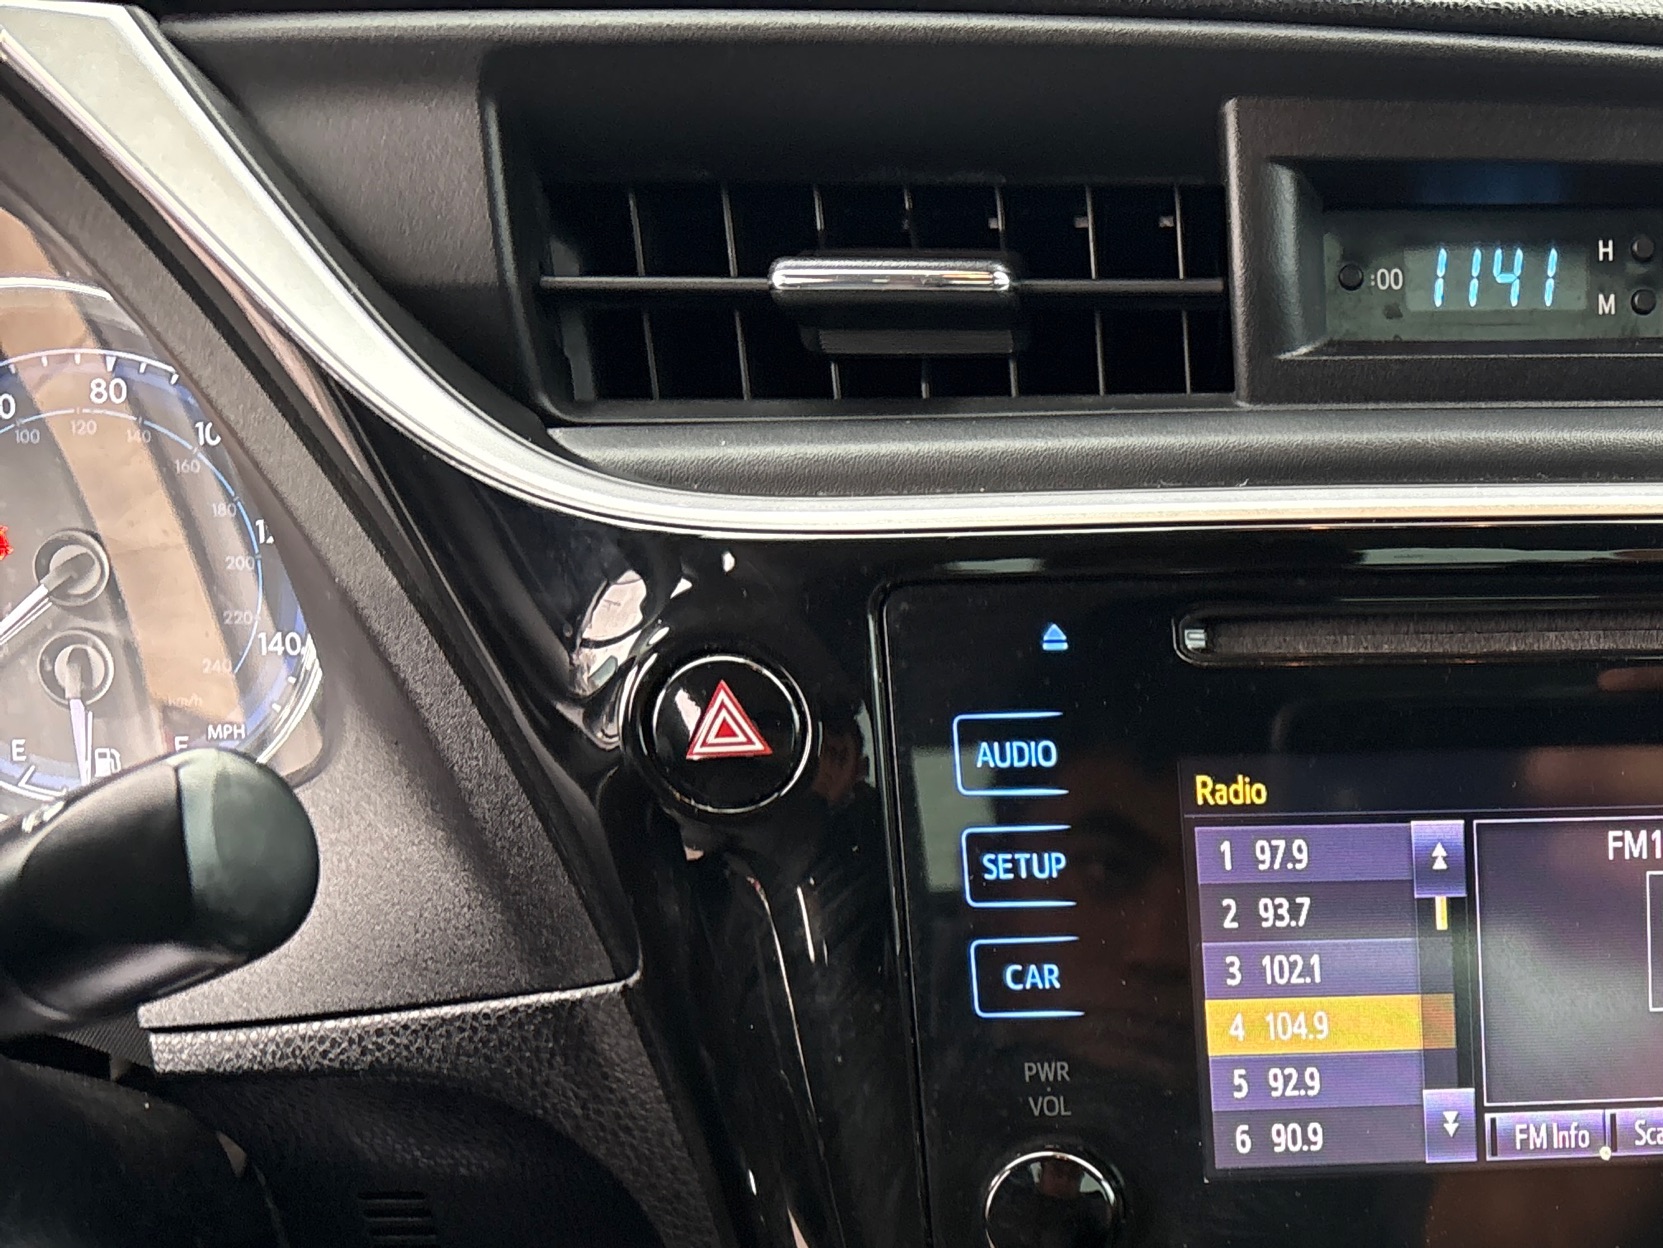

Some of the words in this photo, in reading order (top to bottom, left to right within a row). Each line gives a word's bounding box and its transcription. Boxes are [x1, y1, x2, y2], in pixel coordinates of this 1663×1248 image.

[1597, 239, 1614, 262] H
[1433, 247, 1558, 308] 1141
[1597, 293, 1616, 315] M
[89, 376, 128, 404] 80
[14, 429, 41, 445] 100
[71, 419, 98, 435] 120
[126, 428, 152, 444] 140
[194, 421, 222, 446] 10
[174, 459, 201, 475] 160
[211, 502, 238, 518] 180
[225, 555, 255, 571] 200
[223, 610, 253, 626] 220
[257, 631, 301, 657] 140
[202, 658, 233, 674] 240
[207, 723, 246, 741] MPH
[11, 738, 27, 762] E
[976, 739, 1058, 769] AUDIO
[1194, 773, 1268, 807] Radio
[981, 853, 1067, 882] SETUP
[1219, 841, 1233, 871] 1
[1254, 840, 1309, 871] 97.9
[1221, 898, 1239, 929] 2
[1258, 898, 1311, 929] 93.7
[1003, 962, 1061, 992] CAR
[1224, 956, 1242, 986] 3
[1260, 953, 1323, 985] 102.1
[1228, 1012, 1246, 1042] 4
[1264, 1010, 1329, 1041] 104.9
[1023, 1061, 1071, 1084] PWR
[1232, 1068, 1248, 1100] 5
[1267, 1067, 1322, 1098] 92.9
[1028, 1096, 1072, 1118] VOL
[1234, 1124, 1252, 1155] 6
[1270, 1122, 1324, 1154] 90.9
[1515, 1127, 1549, 1152] FM
[1554, 1123, 1591, 1152] Info
